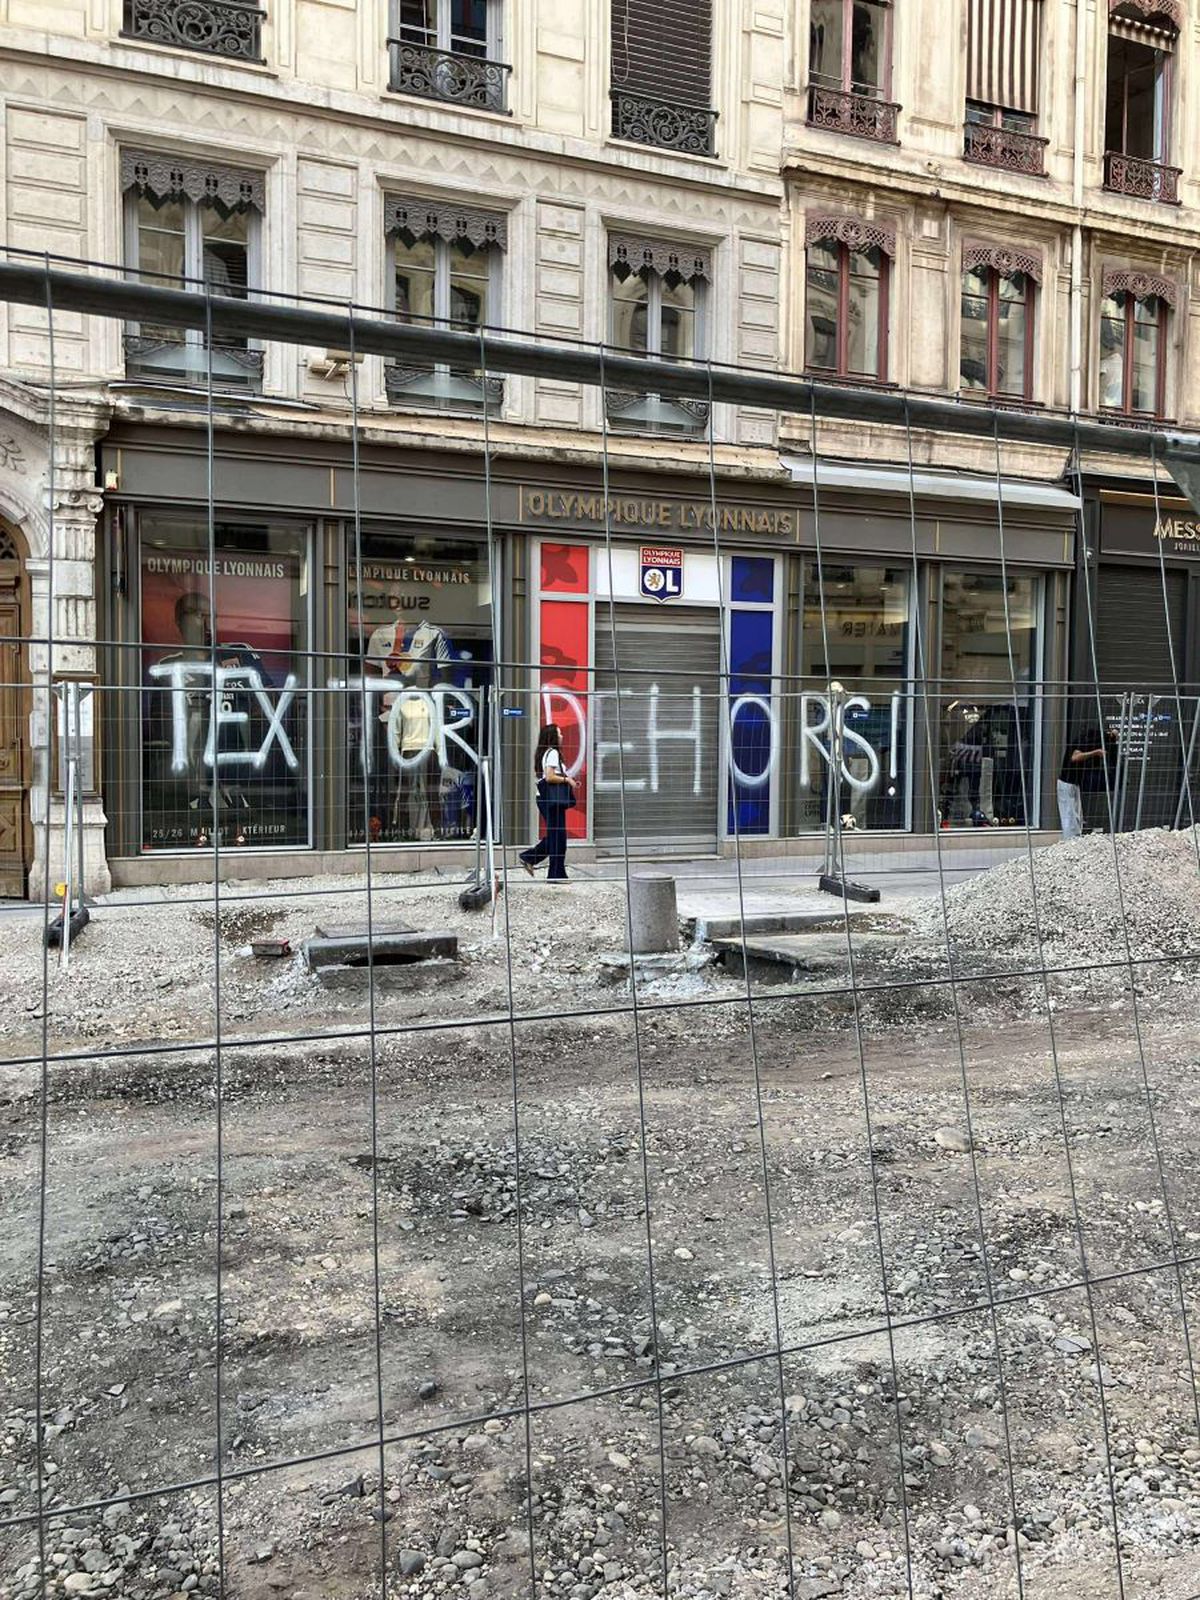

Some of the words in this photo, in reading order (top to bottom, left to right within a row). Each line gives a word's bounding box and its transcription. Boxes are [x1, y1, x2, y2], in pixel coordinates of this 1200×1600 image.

[528, 492, 672, 526] OLYMPIQUE
[680, 503, 793, 534] LYONNAIS
[643, 549, 680, 558] OLYMPIQUE
[643, 556, 680, 565] LYONNAIS
[147, 557, 220, 575] OLYMPIQUE
[223, 561, 284, 578] LYONNAIS
[348, 565, 408, 580] LMPIQUE
[413, 570, 470, 584] LYONNAIS
[643, 568, 679, 592] OL
[241, 823, 287, 835] XTÉRIEUR
